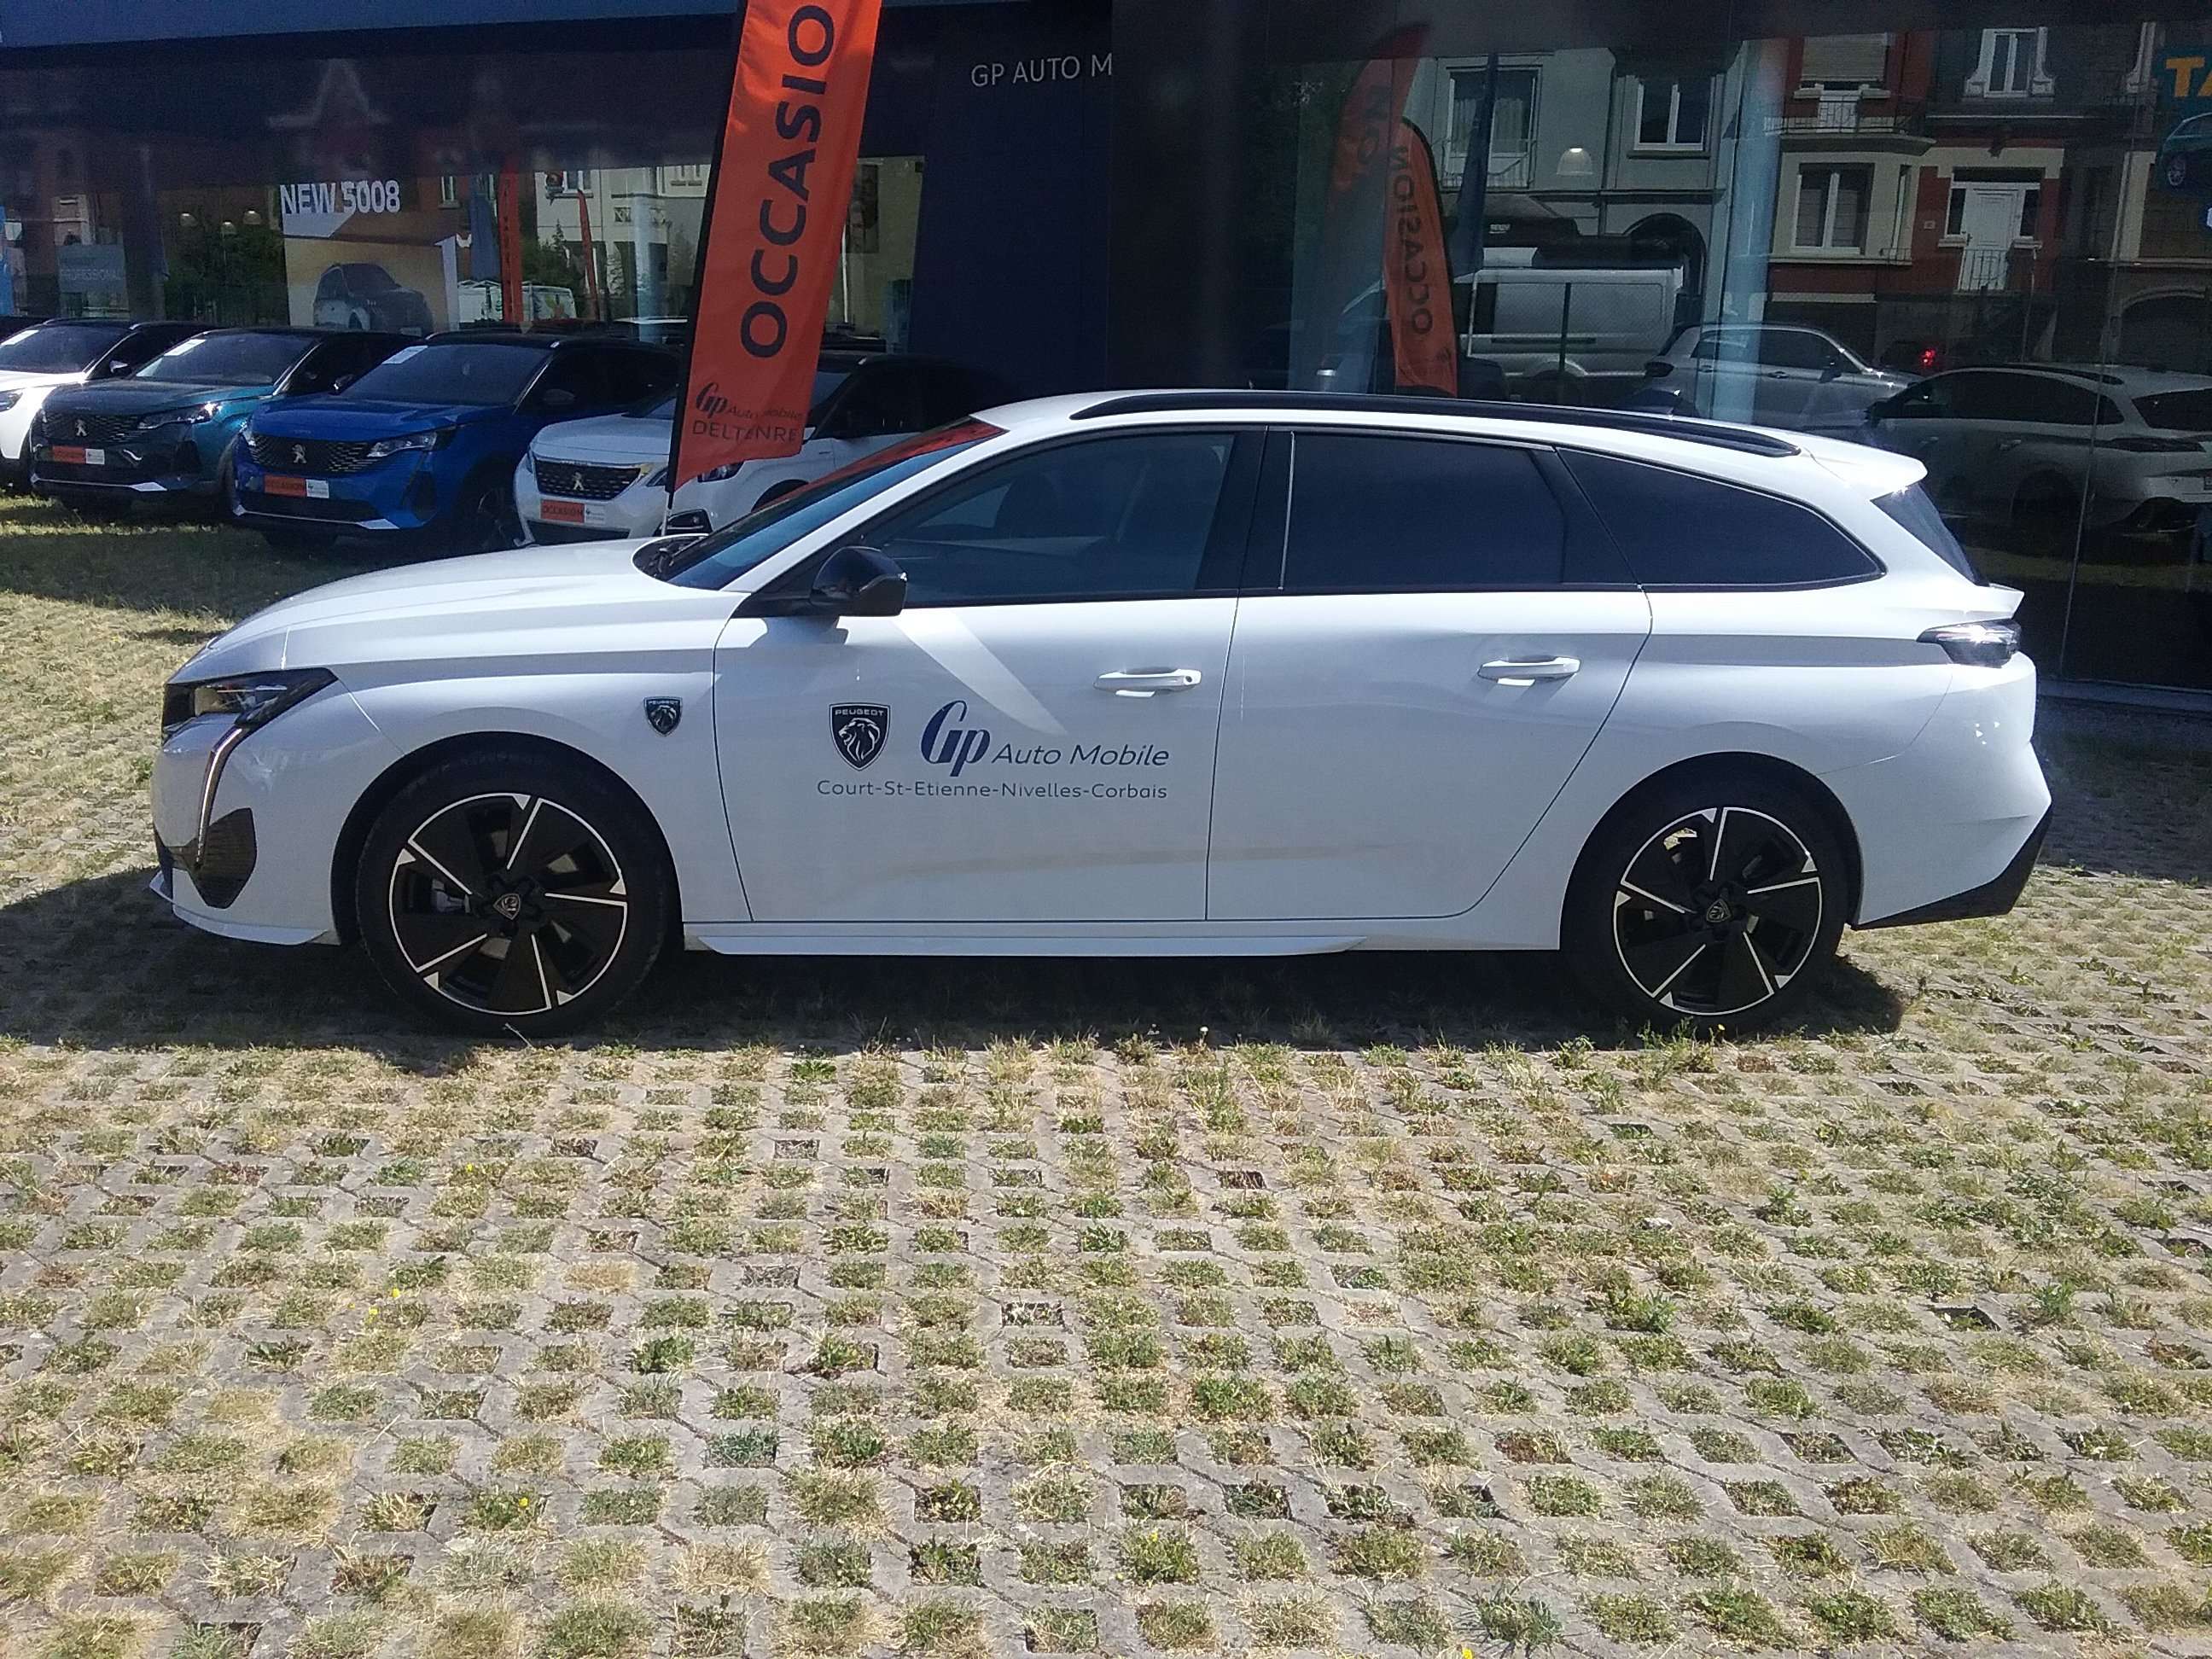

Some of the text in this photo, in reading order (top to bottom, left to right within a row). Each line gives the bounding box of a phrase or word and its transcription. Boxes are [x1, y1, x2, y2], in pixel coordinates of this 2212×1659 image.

[970, 52, 1113, 87] GP AUTO M
[280, 179, 401, 214] NEW 5008
[835, 708, 884, 717] PEUGEOT
[991, 743, 1062, 765] Auto
[1069, 743, 1169, 766] Mobile
[817, 780, 1167, 799] Court-St-Etienne-Nivelles-Corbais
